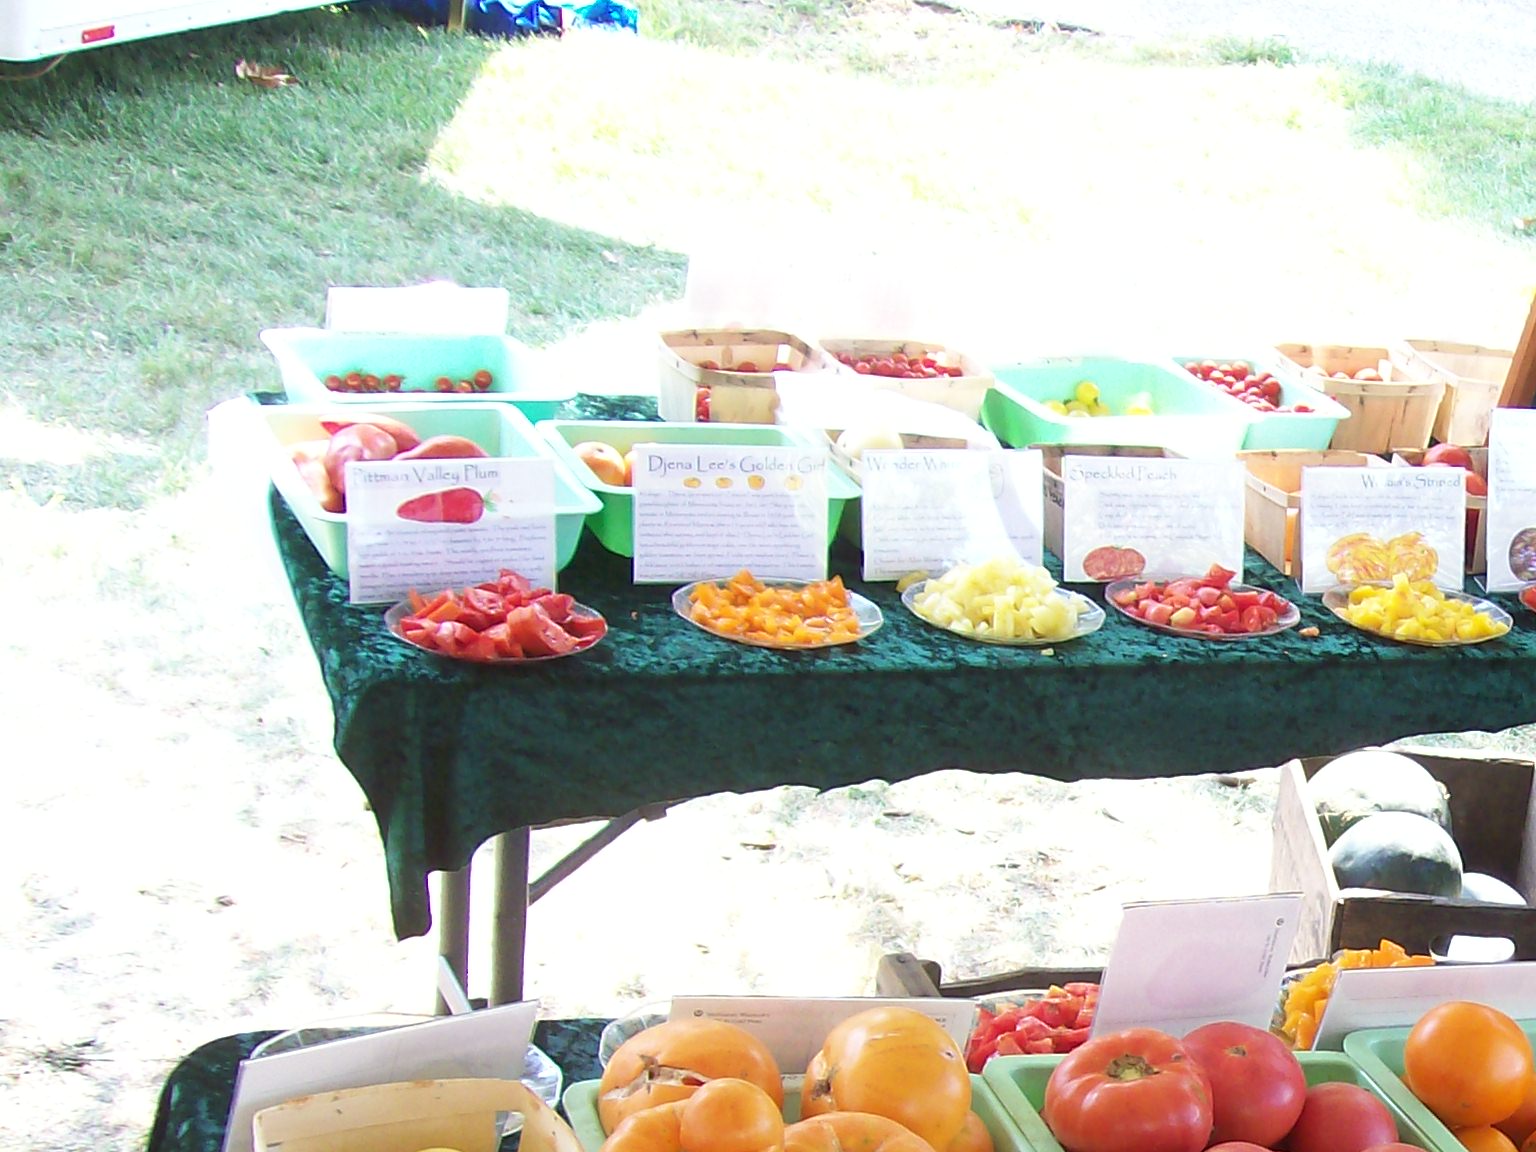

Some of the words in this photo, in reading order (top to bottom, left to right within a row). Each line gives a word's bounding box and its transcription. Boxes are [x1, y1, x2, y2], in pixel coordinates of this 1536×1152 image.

[354, 467, 409, 485] Pittman
[412, 466, 460, 484] Valley
[464, 464, 498, 482] Plum
[648, 455, 692, 478] Djena
[696, 456, 736, 473] Lee's
[740, 456, 793, 473] Golden
[1070, 464, 1134, 483] Speckled
[1138, 466, 1176, 482] Peach
